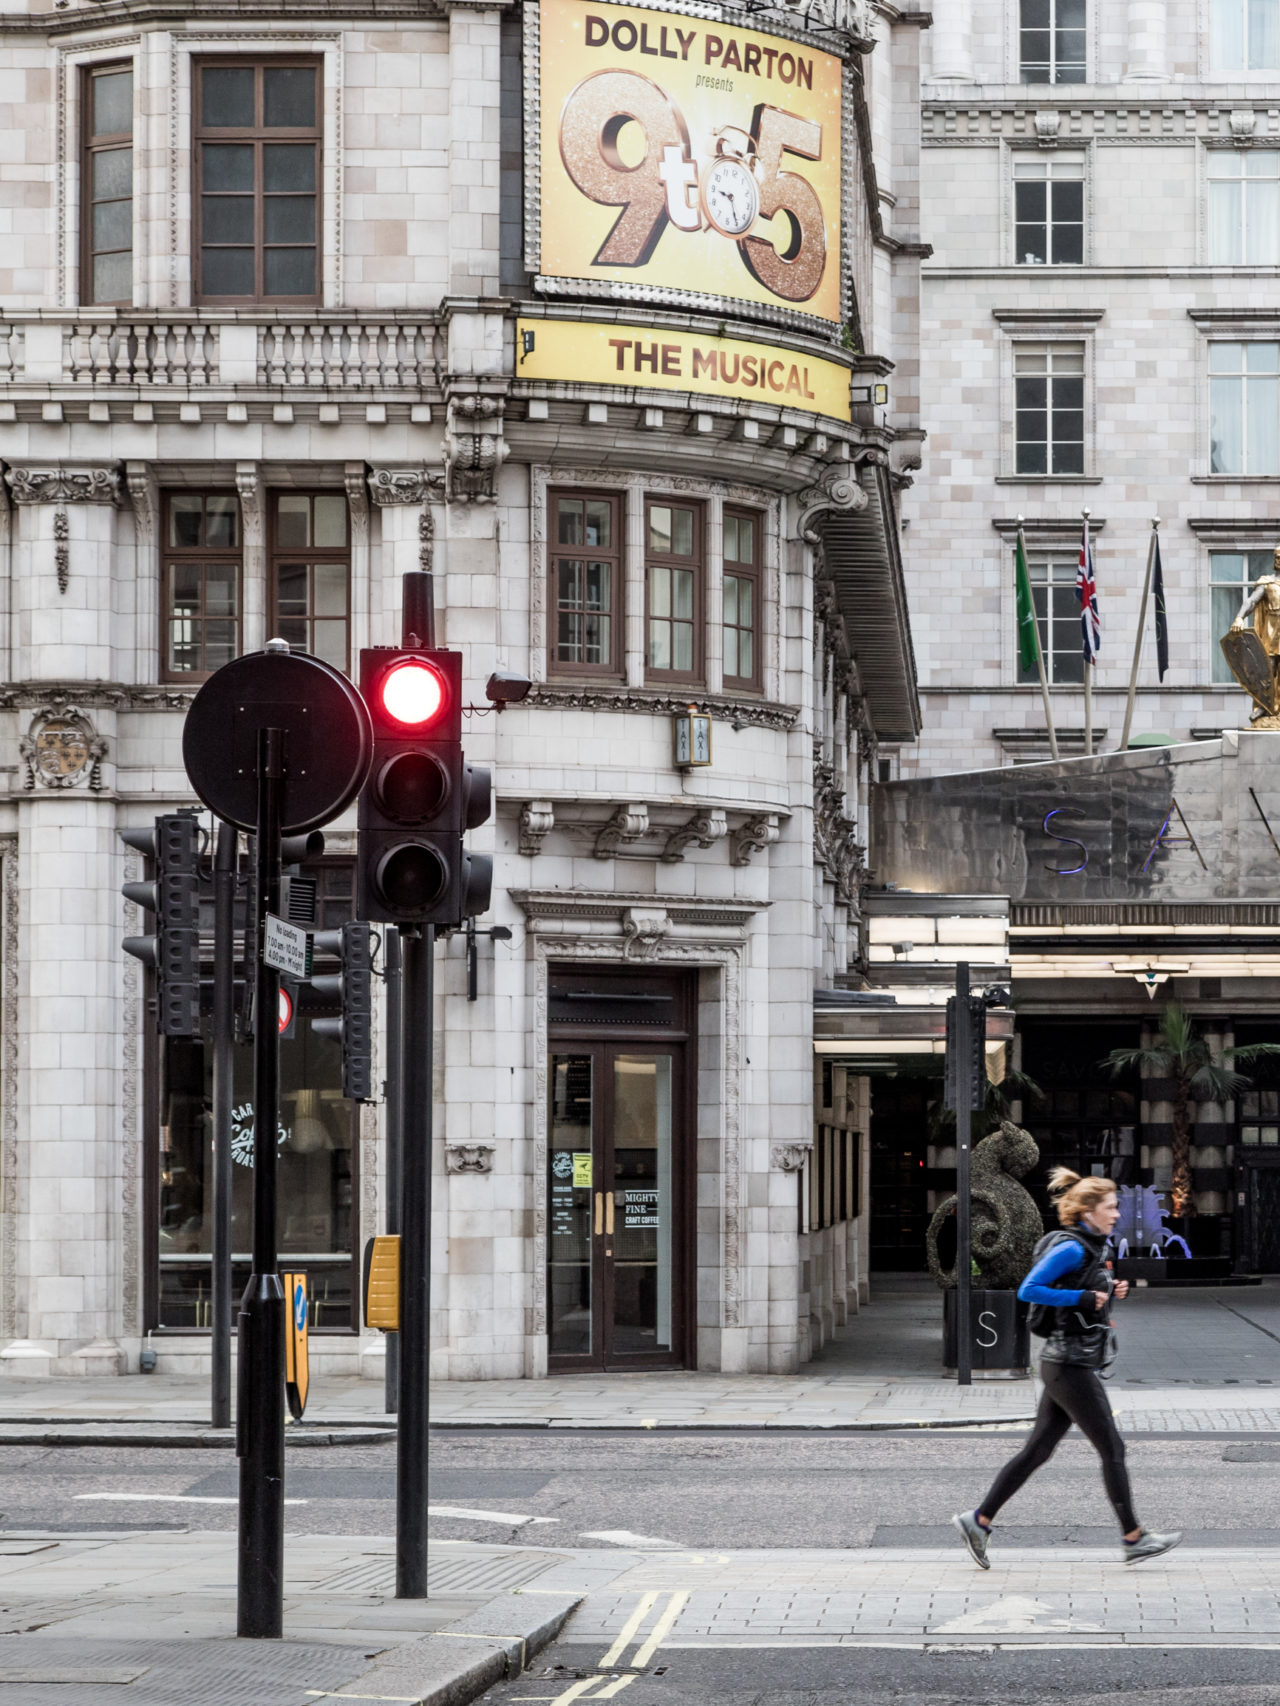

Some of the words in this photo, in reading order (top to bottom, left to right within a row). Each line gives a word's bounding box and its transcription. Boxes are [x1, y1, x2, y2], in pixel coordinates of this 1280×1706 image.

[585, 14, 697, 61] DOLLY
[704, 34, 814, 91] PARTON
[695, 73, 734, 93] presents
[559, 67, 692, 268] 9
[737, 102, 828, 303] 5
[608, 338, 682, 377] THE
[692, 347, 816, 401] MUSICAL
[697, 719, 705, 761] TAXI
[276, 923, 283, 935] No
[283, 926, 298, 943] loading
[625, 1193, 660, 1203] MIGHTY
[625, 1204, 647, 1214] FINE
[625, 1216, 641, 1225] CRAFT
[641, 1216, 660, 1225] COFFEE
[976, 1311, 998, 1347] S
